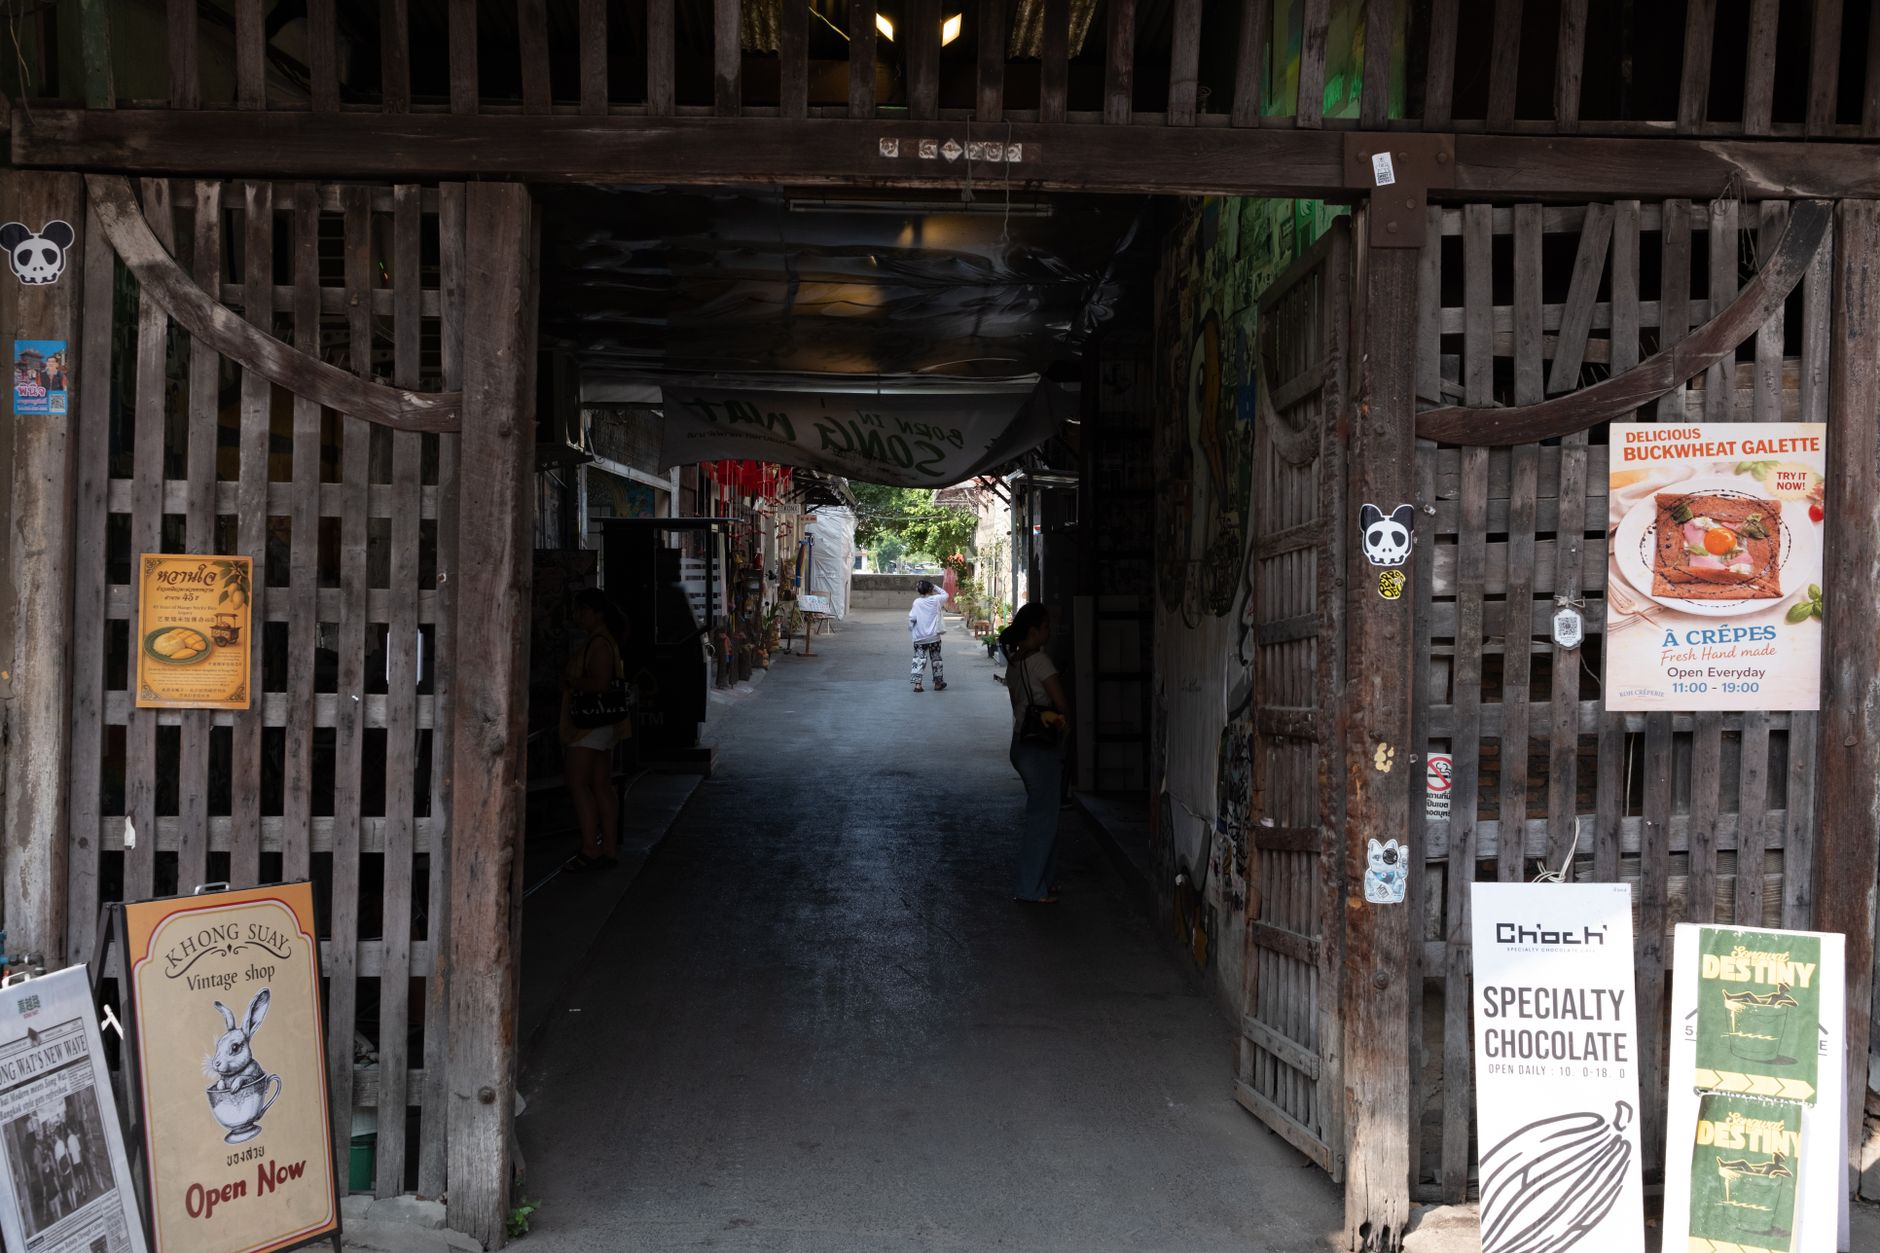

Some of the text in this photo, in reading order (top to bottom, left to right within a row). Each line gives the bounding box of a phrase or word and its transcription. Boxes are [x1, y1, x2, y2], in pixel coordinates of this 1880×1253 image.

[1625, 428, 1701, 443] DELICIOUS
[1623, 437, 1820, 462] BUCKWHEAT GALETTE
[1776, 471, 1807, 481] TRY IT
[1776, 482, 1806, 491] NOW!
[1660, 643, 1777, 667] Fresh Hand made
[1667, 667, 1766, 680] Open Everyday
[1672, 682, 1708, 693] 11:00
[1721, 682, 1760, 693] 19:00
[165, 923, 289, 969] KHONG SUAY
[186, 964, 275, 991] Vintage shop
[1702, 954, 1816, 988] DESTINY
[1483, 985, 1625, 1021] SPECIALTY
[16, 1050, 44, 1077] WAT'S
[43, 1044, 64, 1066] NEW
[63, 1035, 87, 1057] WAVE
[1484, 1028, 1628, 1063] CHOCOLATE
[1488, 1064, 1514, 1074] OPEN
[1518, 1064, 1546, 1075] DAILY
[1697, 1120, 1802, 1158] DESTINY
[185, 1160, 306, 1219] Open Now
